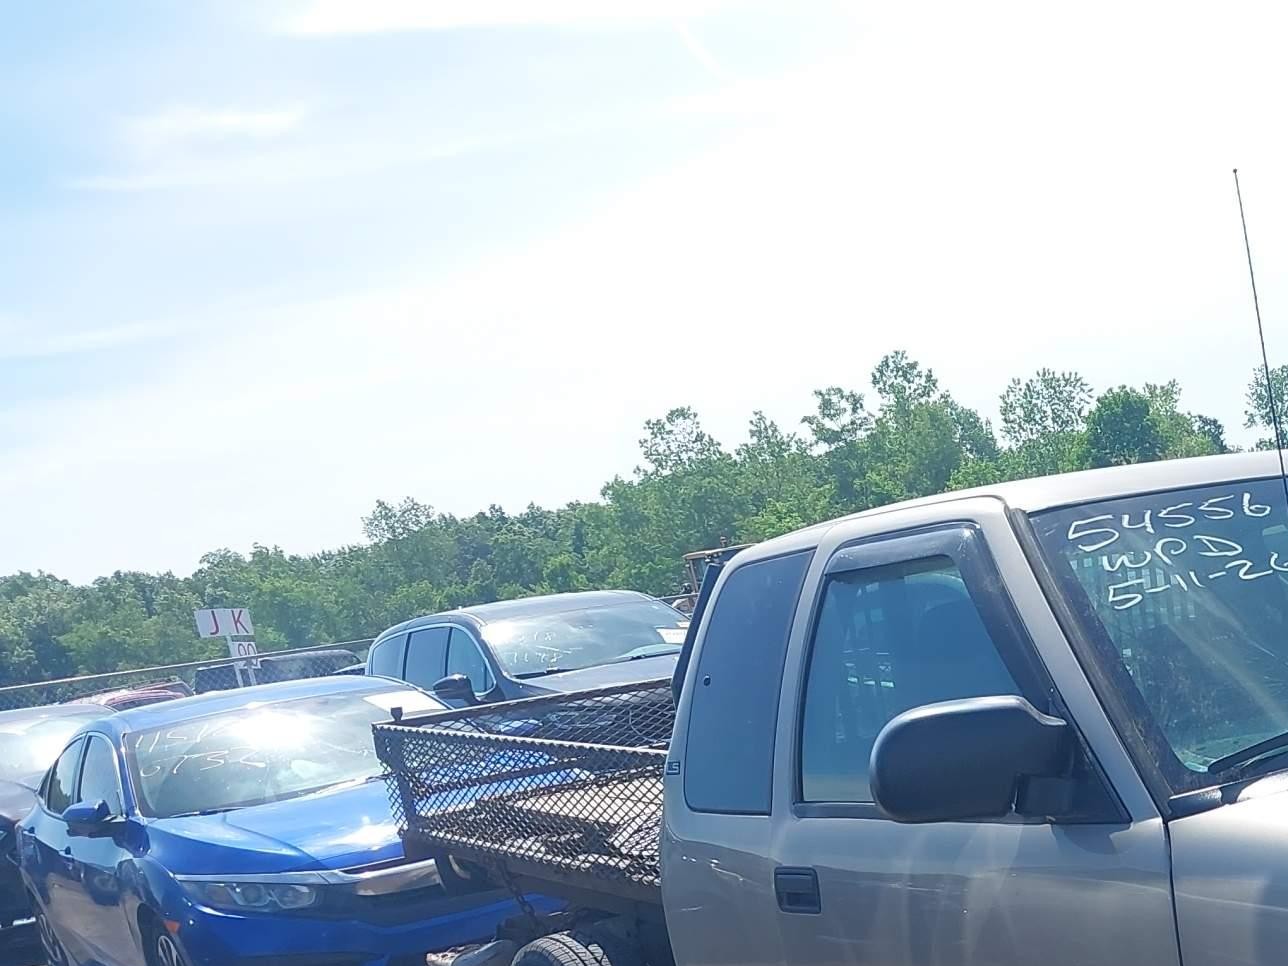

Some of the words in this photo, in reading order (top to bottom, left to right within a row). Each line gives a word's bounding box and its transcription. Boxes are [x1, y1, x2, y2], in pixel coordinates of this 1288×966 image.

[1067, 493, 1271, 551] 54556
[210, 610, 220, 635] J
[231, 610, 249, 634] K
